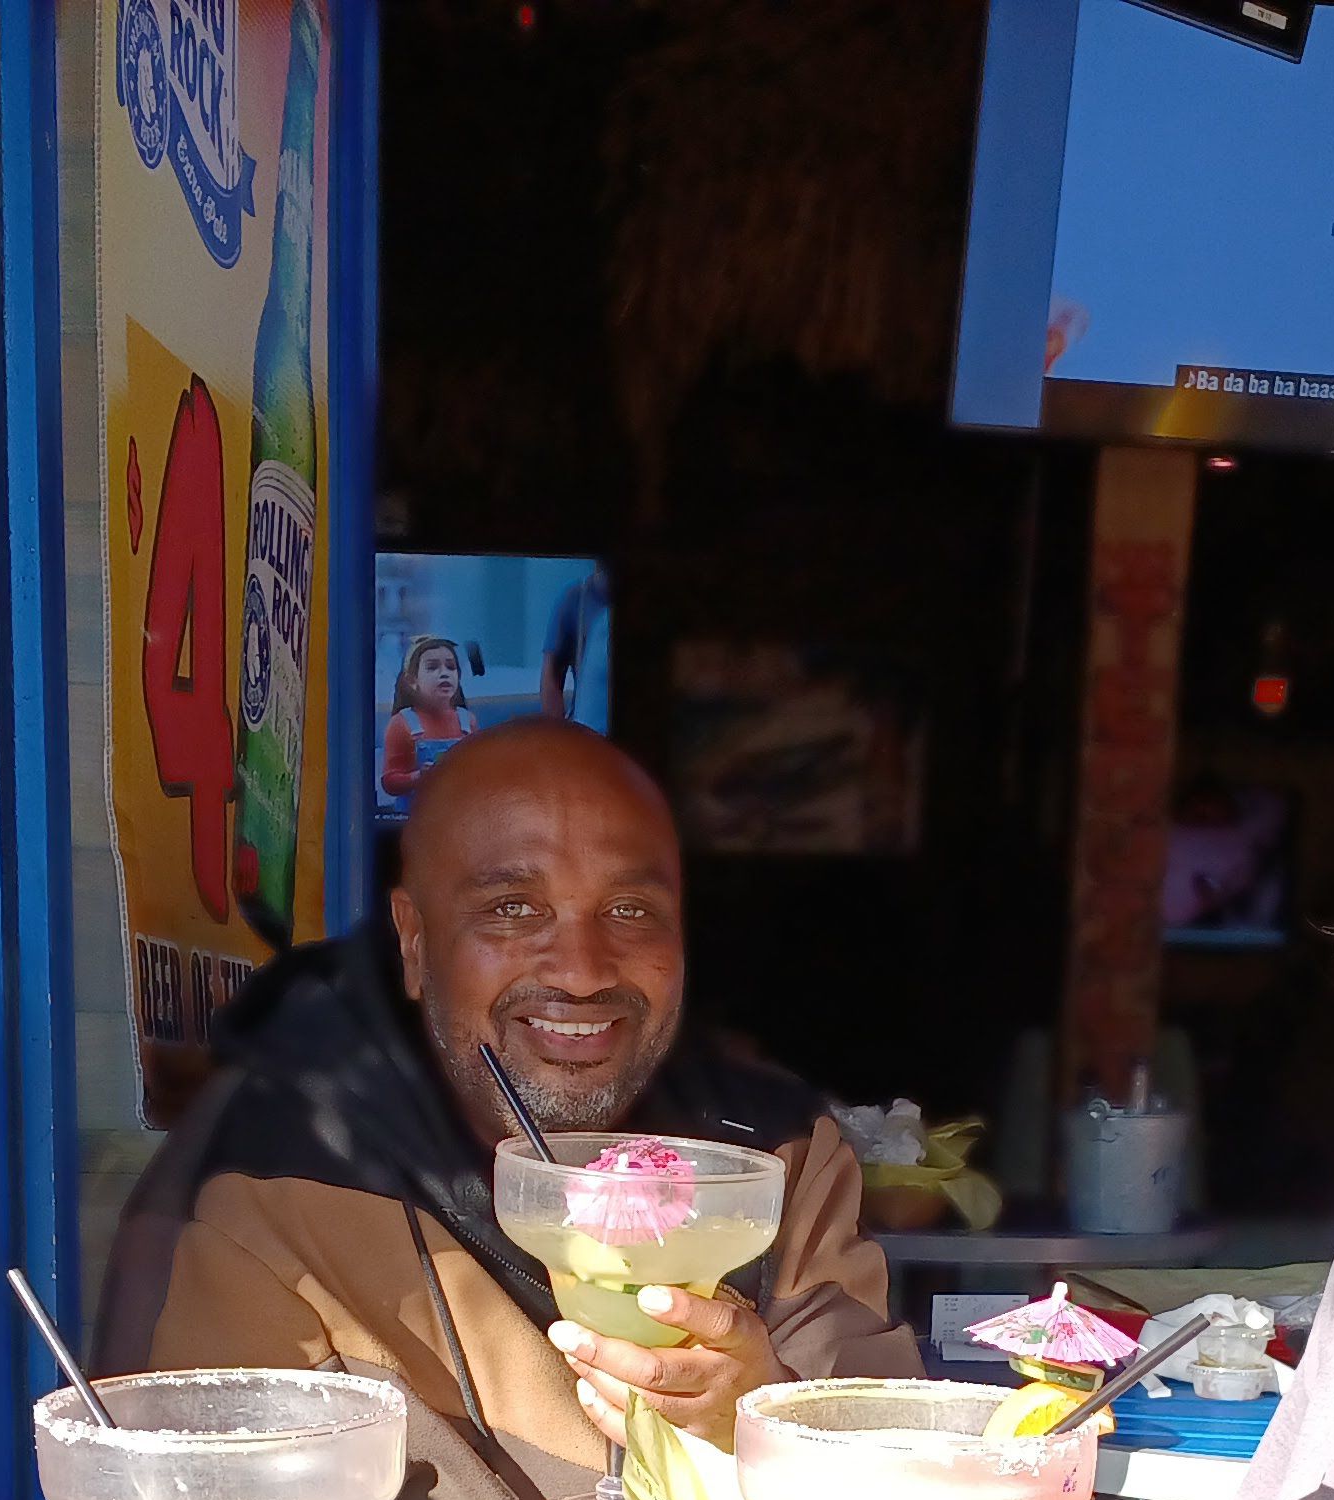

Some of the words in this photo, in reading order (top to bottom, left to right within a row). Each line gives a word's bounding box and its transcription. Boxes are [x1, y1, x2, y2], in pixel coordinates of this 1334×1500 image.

[170, 0, 225, 170] ROCK
[1196, 370, 1219, 391] Ba
[1224, 372, 1244, 393] da
[1249, 373, 1269, 394] ba
[1274, 375, 1295, 396] ba
[251, 499, 309, 610] ROLLING
[271, 576, 306, 680] ROCK
[135, 935, 186, 1044] BEER
